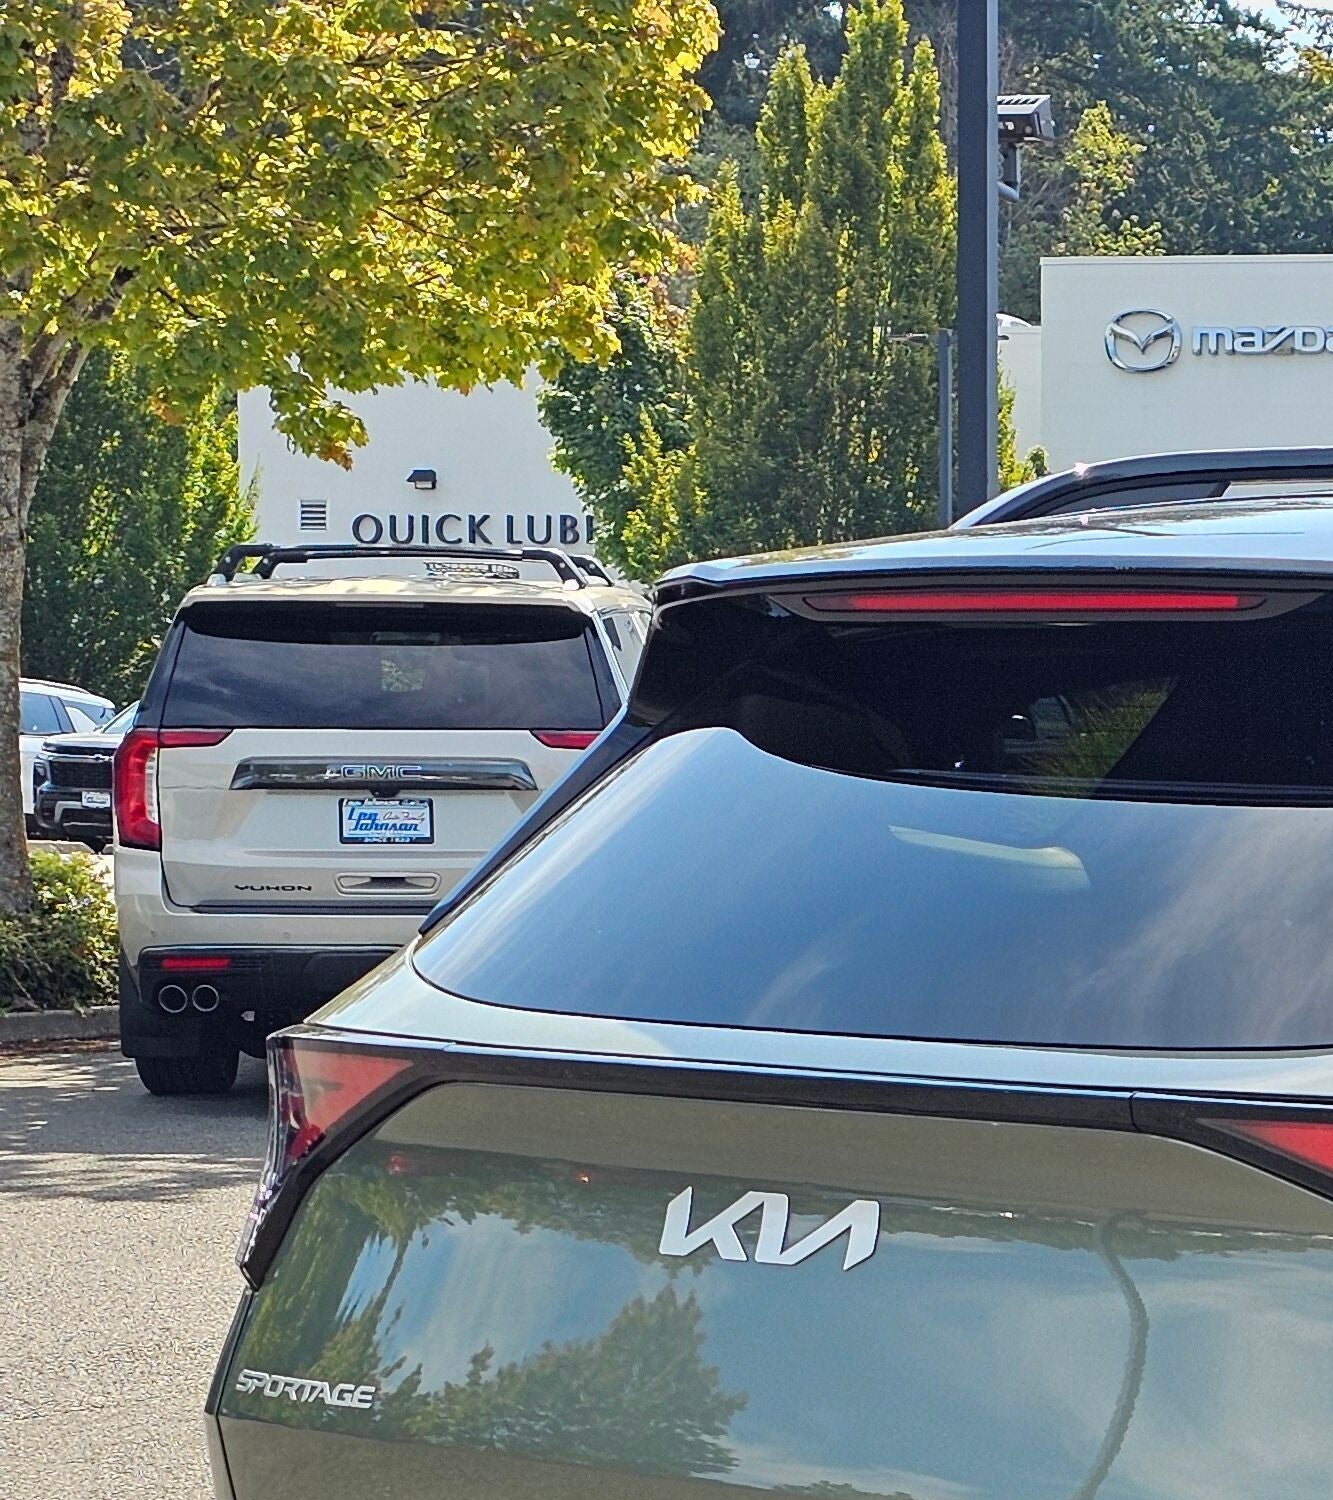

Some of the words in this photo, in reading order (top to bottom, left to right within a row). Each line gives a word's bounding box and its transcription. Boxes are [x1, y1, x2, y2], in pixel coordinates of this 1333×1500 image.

[352, 513, 493, 545] QUICK
[341, 764, 422, 779] GMC
[348, 819, 421, 832] Johnson
[235, 884, 312, 892] YUKON
[659, 1185, 880, 1272] KIA
[235, 1368, 376, 1409] SPORTAGE
